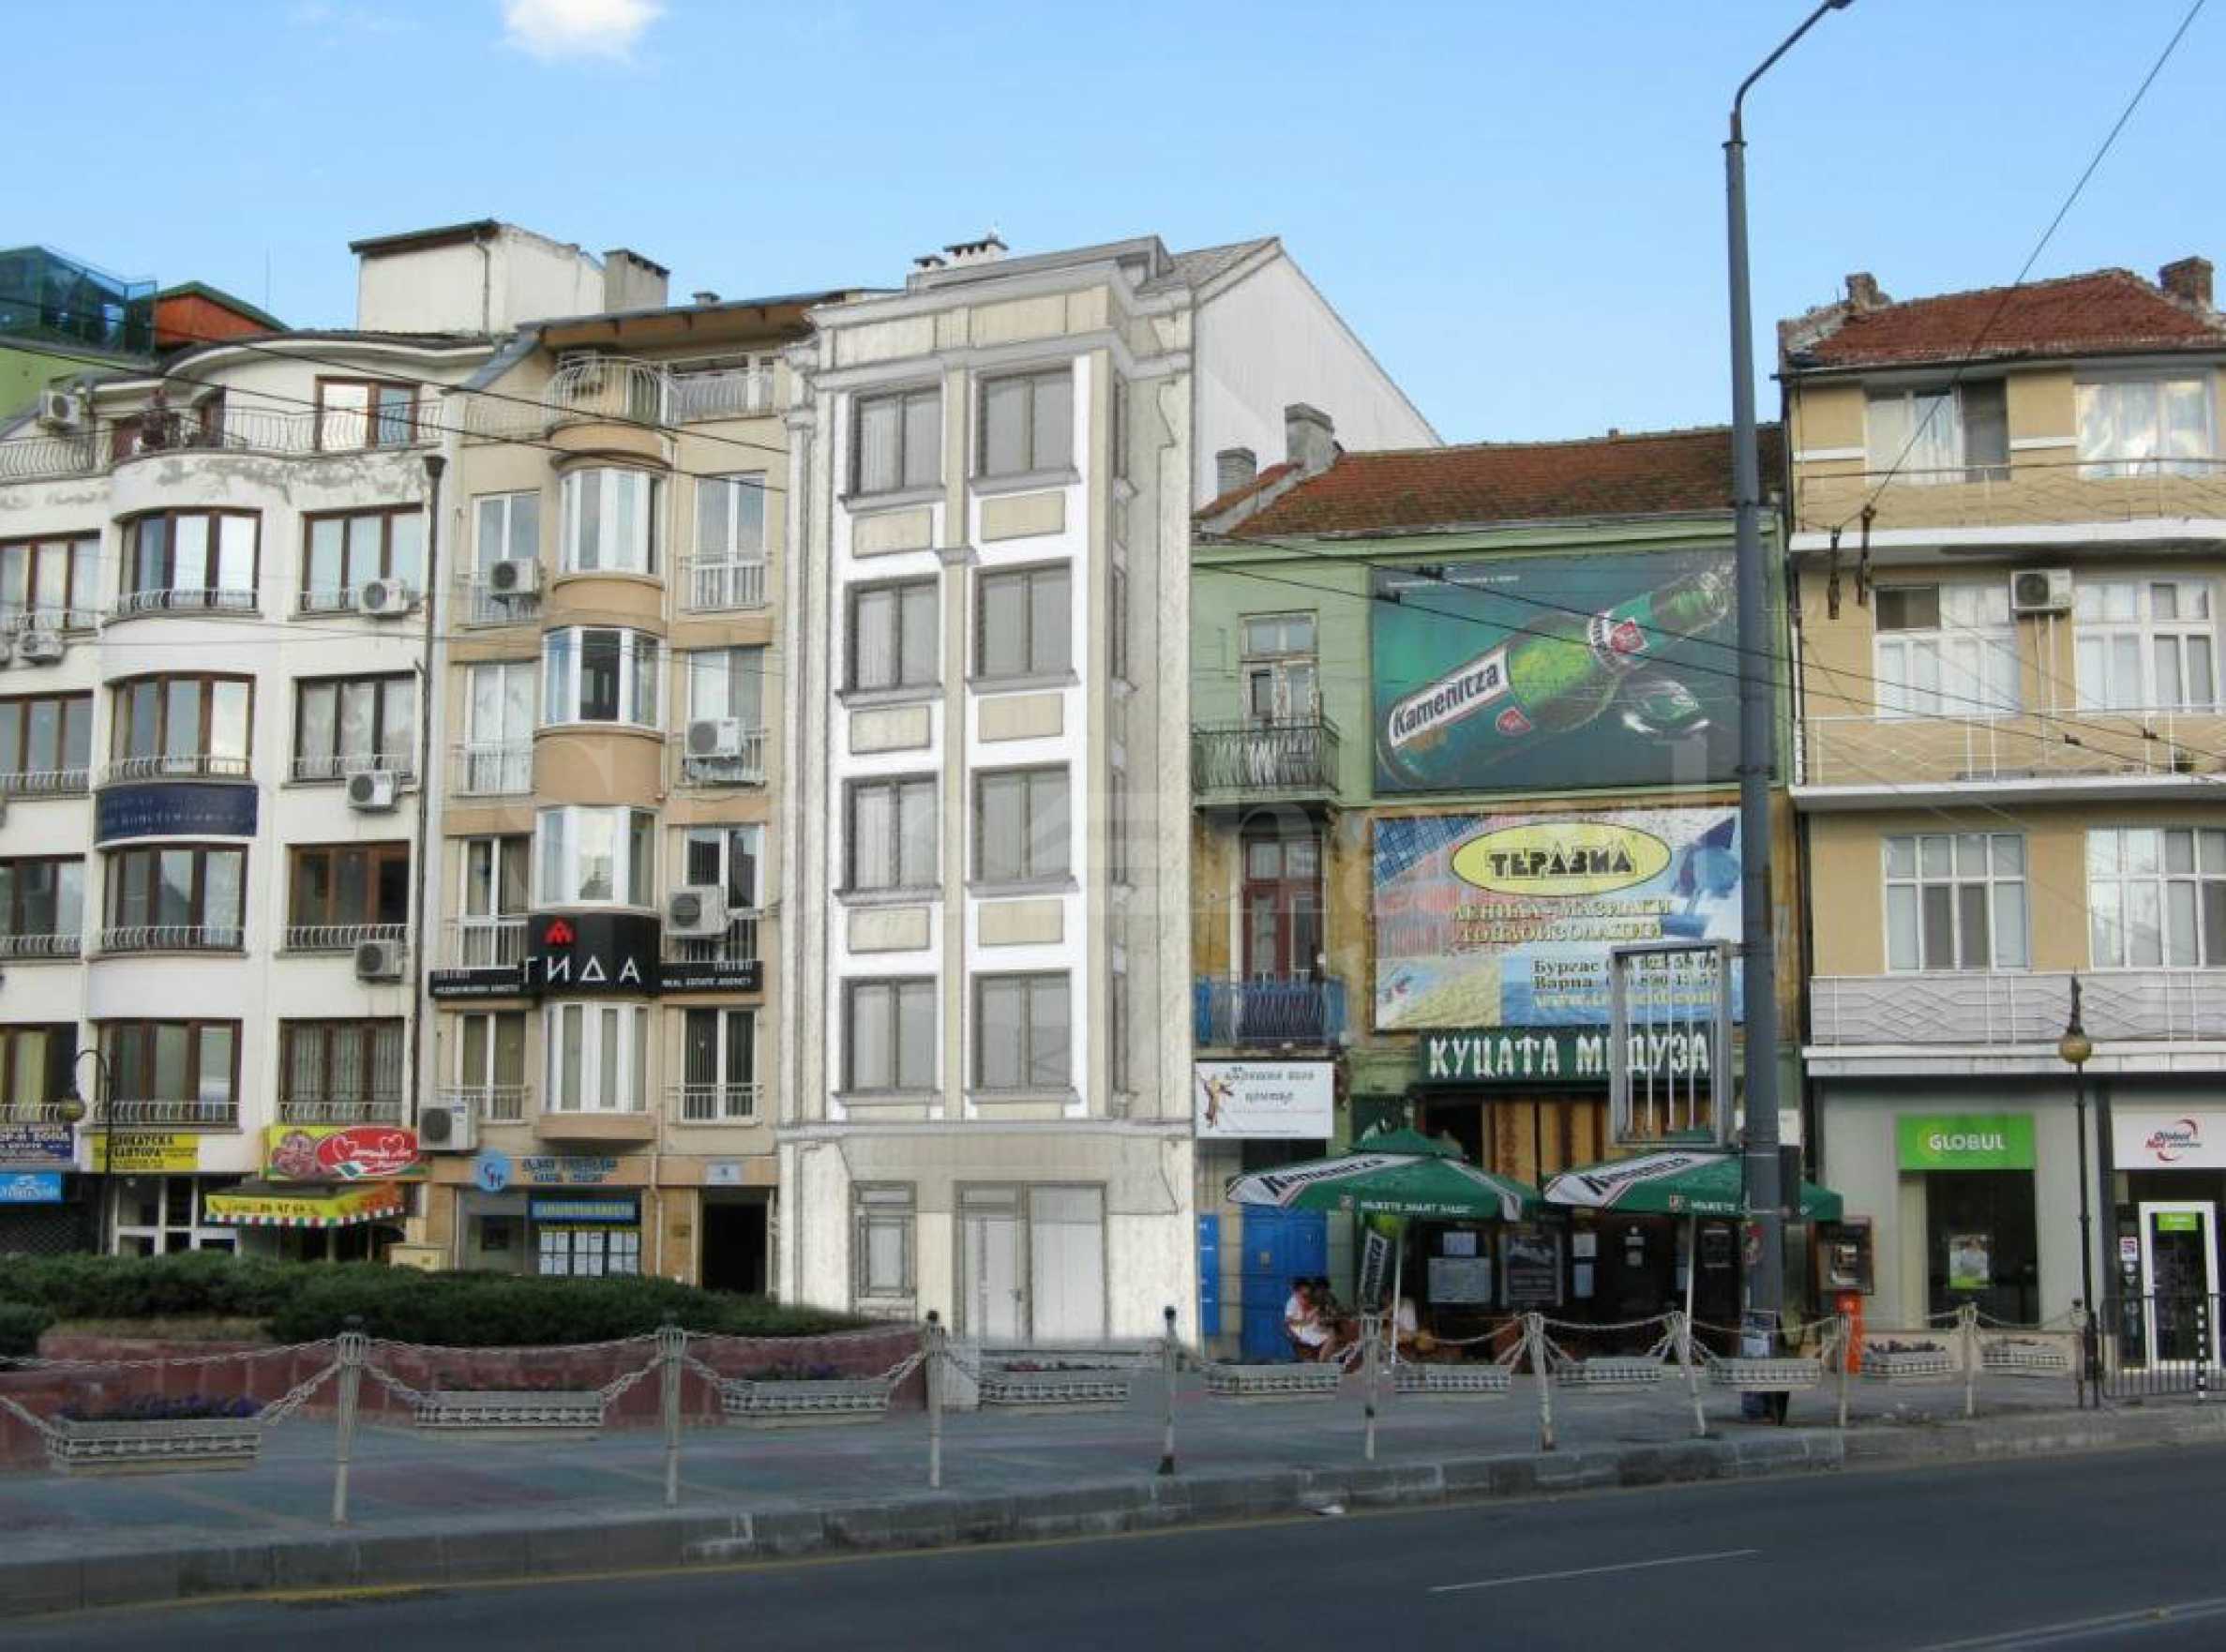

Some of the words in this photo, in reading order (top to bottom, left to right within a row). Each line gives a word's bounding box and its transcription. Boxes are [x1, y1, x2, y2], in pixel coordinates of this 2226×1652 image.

[1392, 664, 1498, 739] Kamenitza
[524, 954, 641, 984] ГИДА
[1534, 960, 1598, 976] Бургас
[1429, 1034, 1559, 1078] КУЦАТА
[1930, 1133, 2006, 1151] GLOBUL
